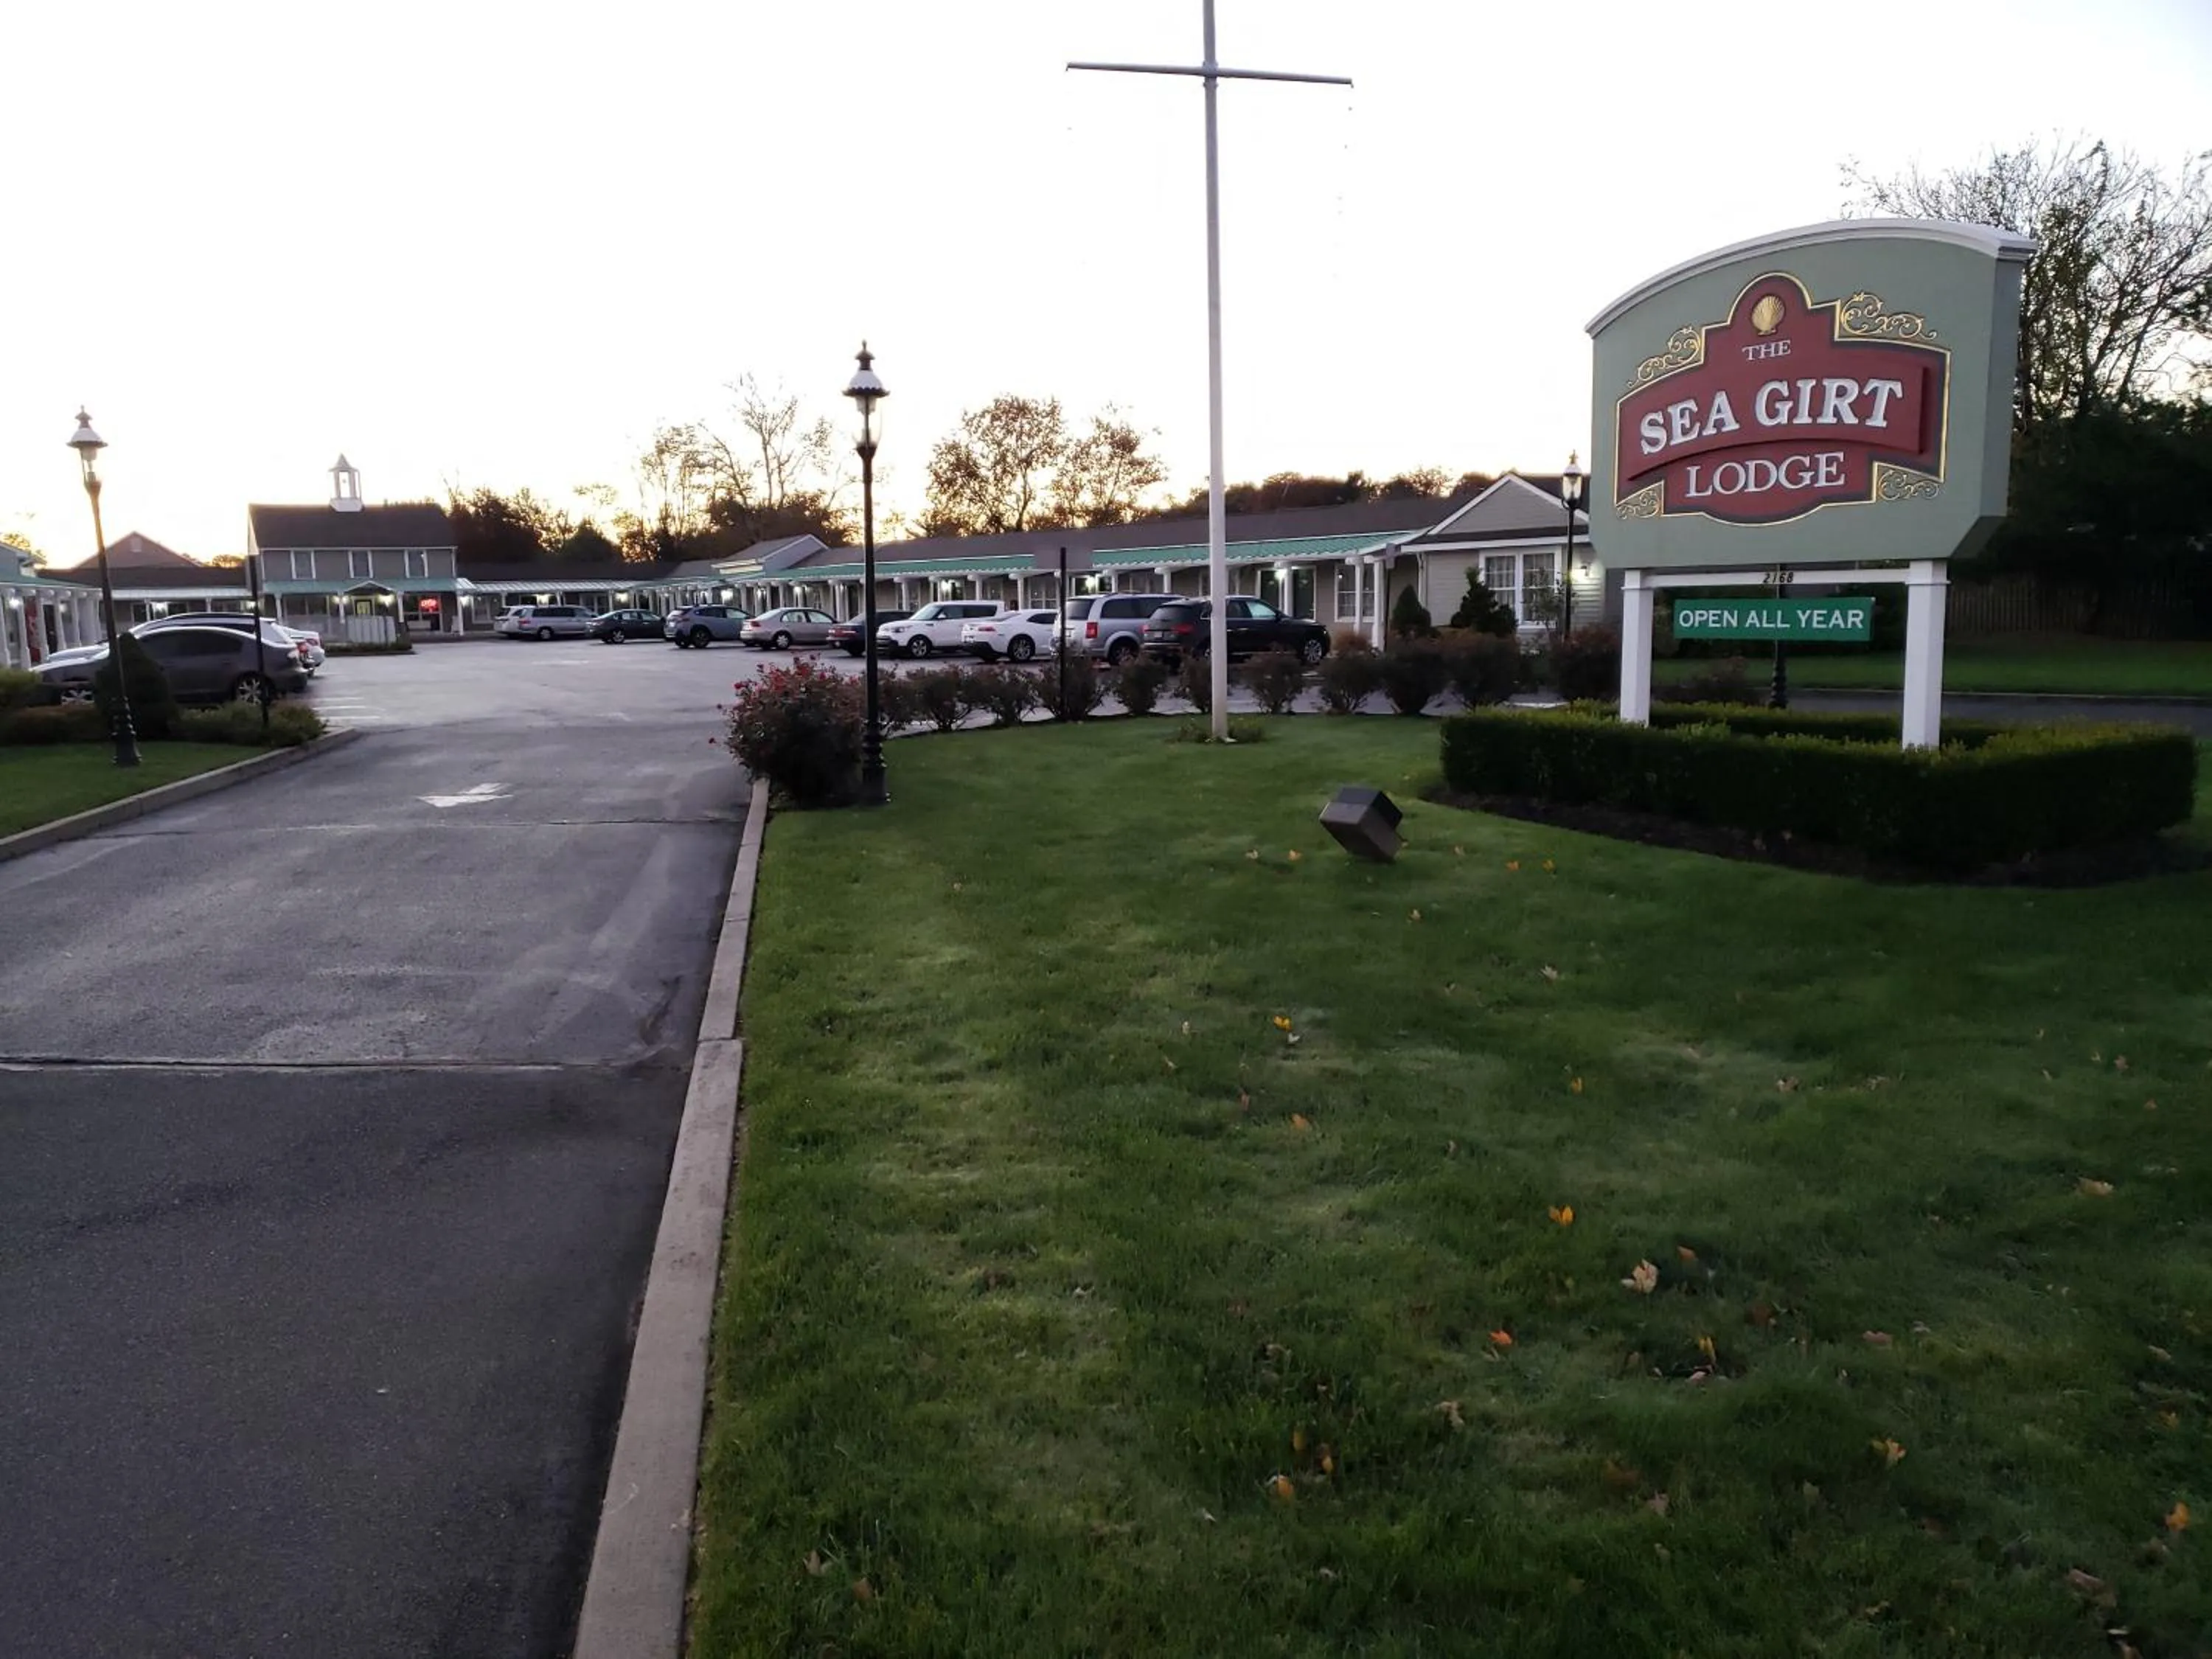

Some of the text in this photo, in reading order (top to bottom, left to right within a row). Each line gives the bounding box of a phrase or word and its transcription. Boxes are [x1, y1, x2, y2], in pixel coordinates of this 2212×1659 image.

[1742, 340, 1792, 361] THE
[1640, 378, 1903, 455] SEA GIRT
[1686, 451, 1845, 498] LODGE
[1763, 571, 1794, 583] 2168
[1679, 610, 1865, 629] OPEN ALL YEAR
